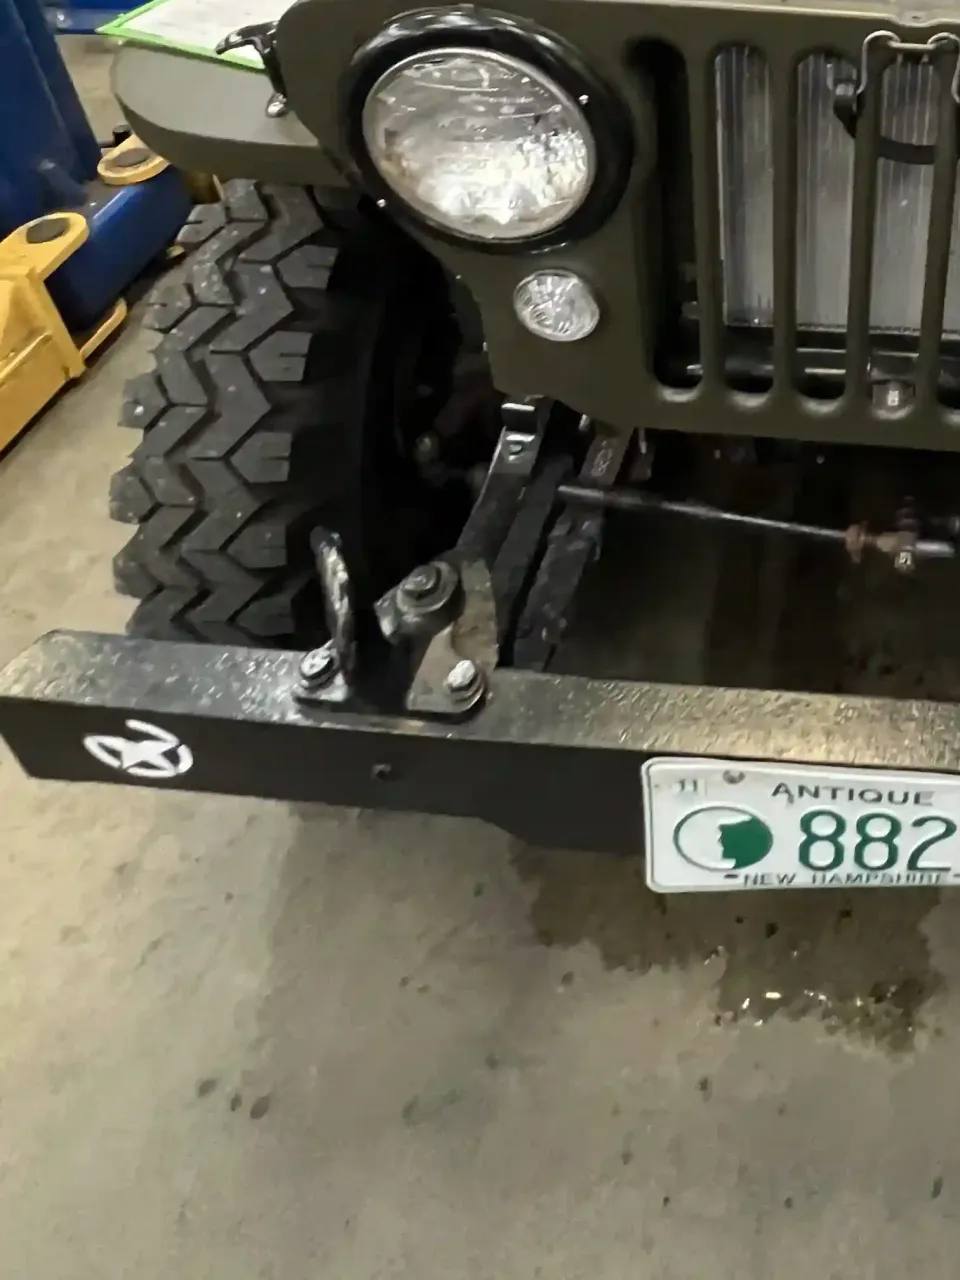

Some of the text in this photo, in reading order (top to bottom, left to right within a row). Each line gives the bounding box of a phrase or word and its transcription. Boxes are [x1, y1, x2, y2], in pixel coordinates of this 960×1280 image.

[770, 782, 935, 806] ANTIQUE
[743, 871, 949, 887] NEW HAMPSHIRE
